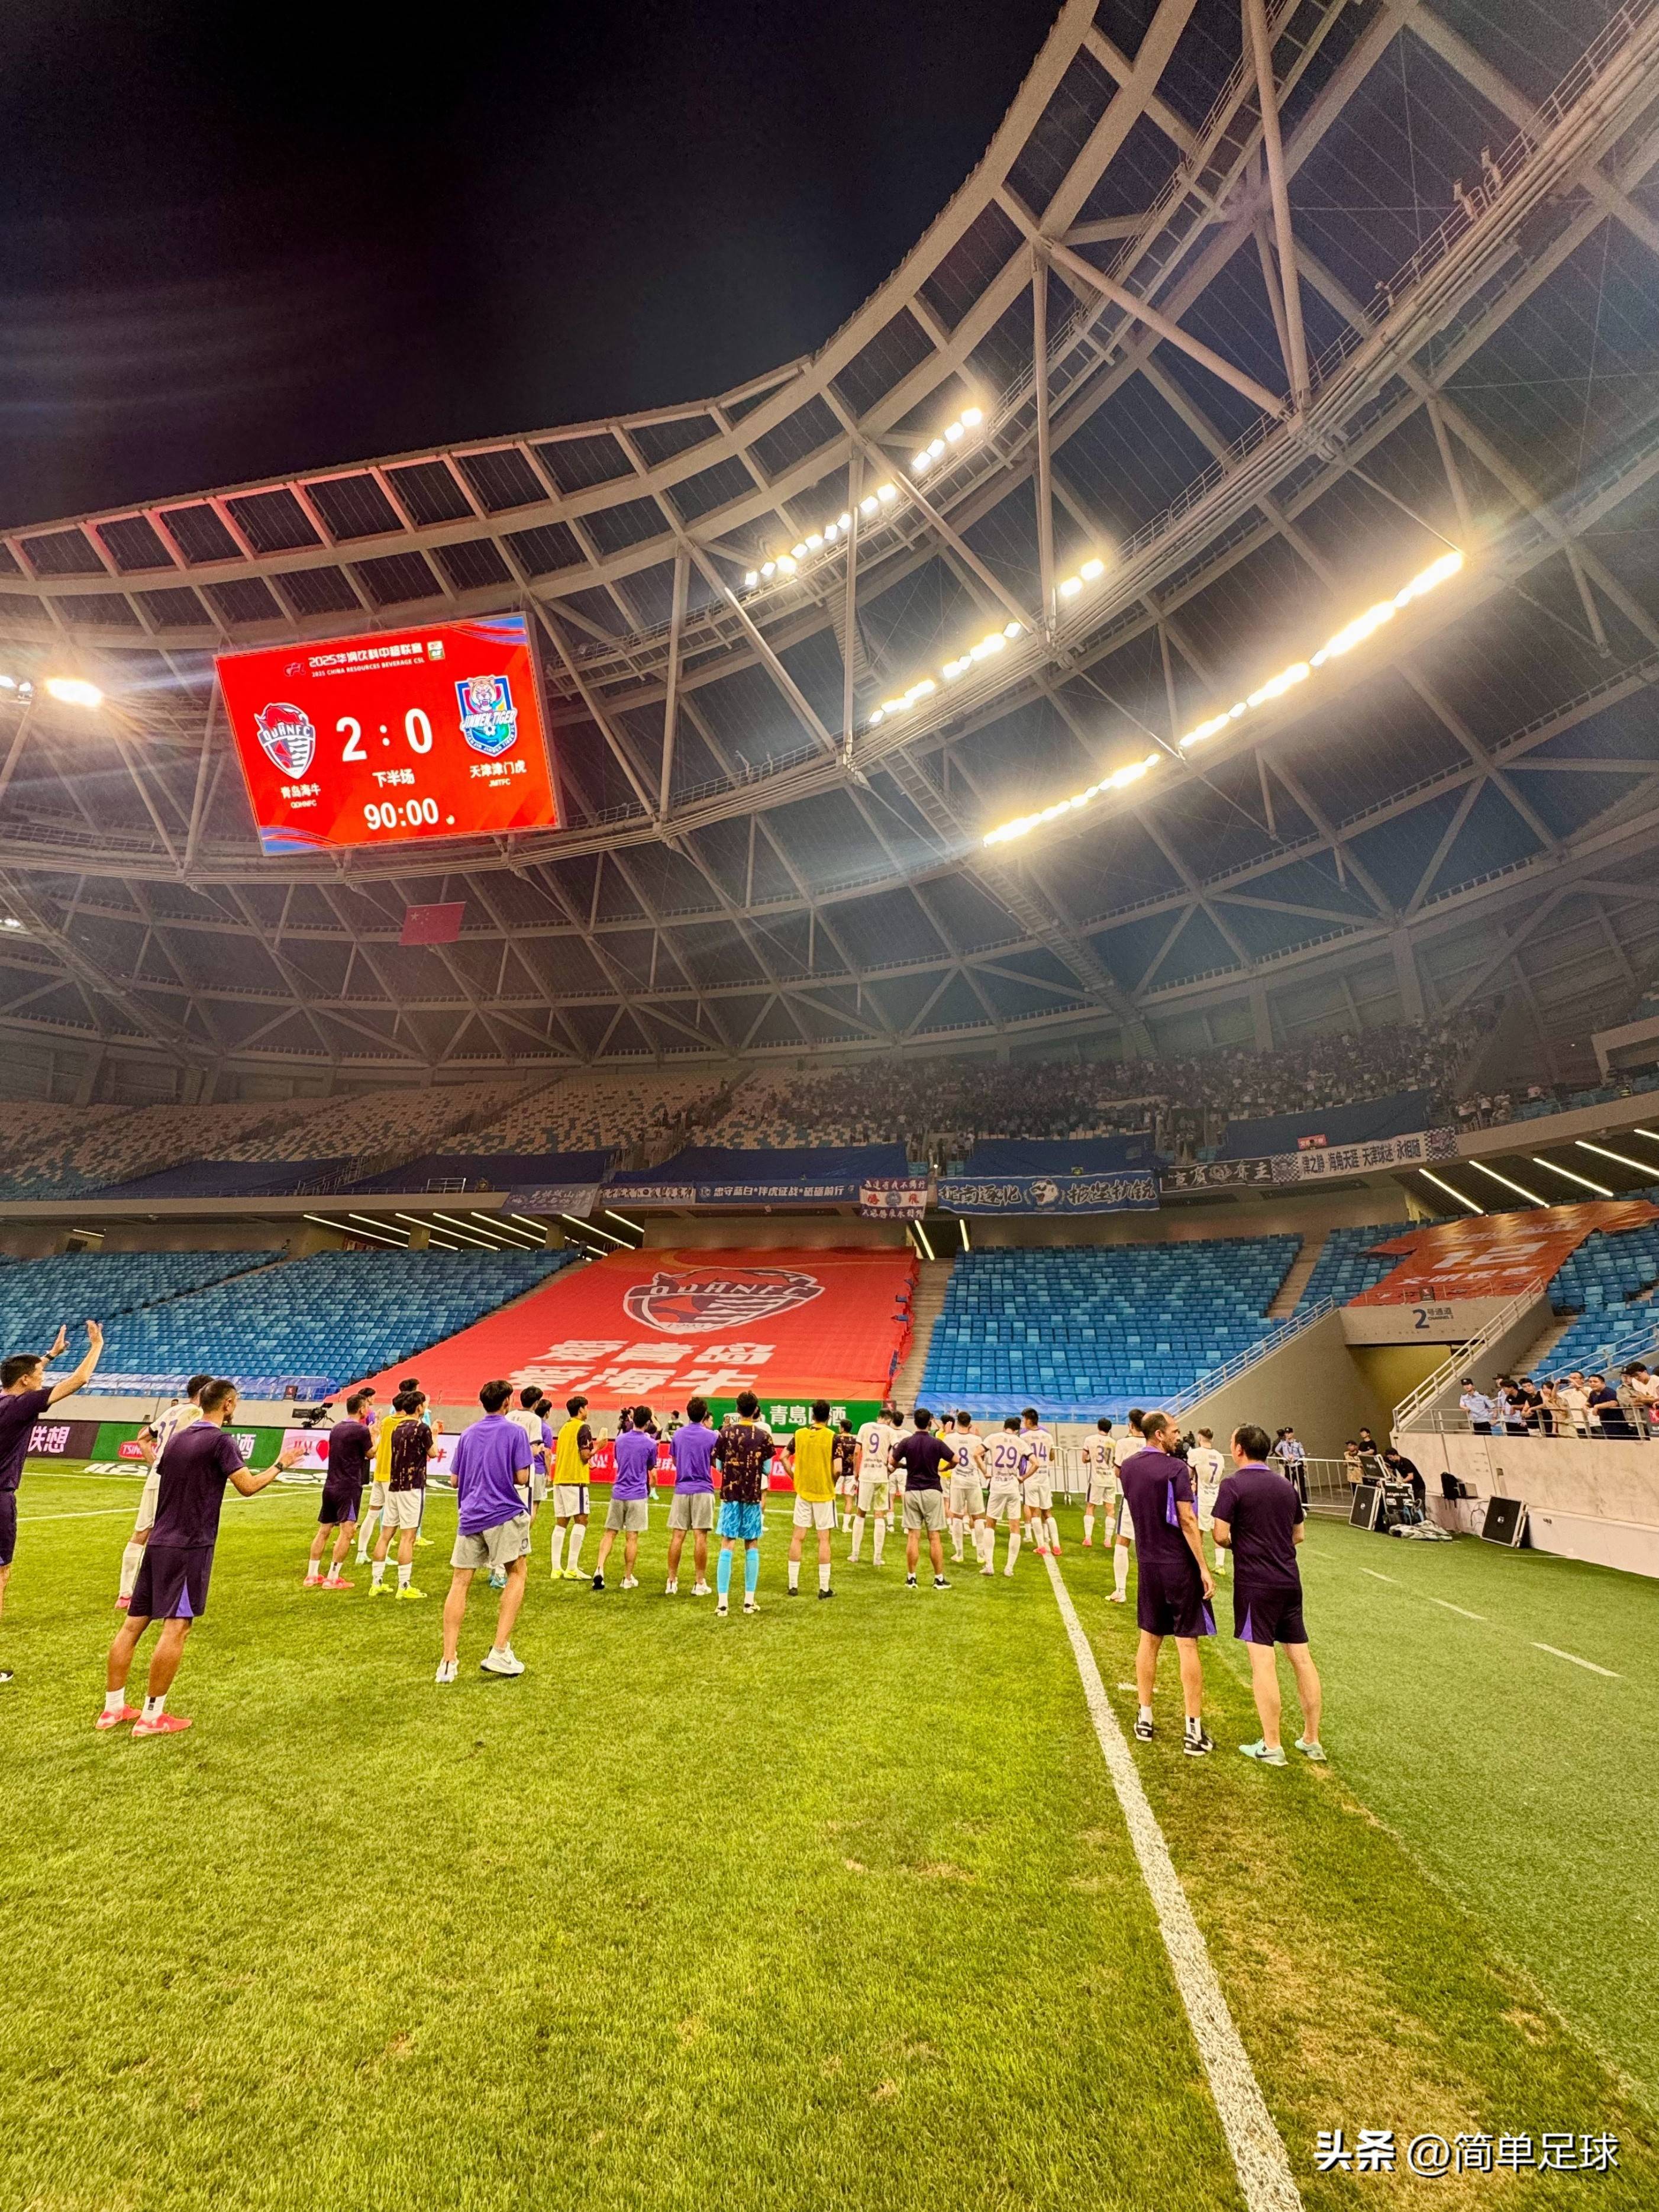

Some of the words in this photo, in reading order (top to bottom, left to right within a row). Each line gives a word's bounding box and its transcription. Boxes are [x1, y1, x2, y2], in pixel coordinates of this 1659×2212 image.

[346, 663, 380, 673] RESOURCES
[381, 660, 412, 669] BEVERAGE
[372, 769, 415, 786] 下半场
[470, 760, 527, 778] 天津津门虎
[280, 783, 321, 799] 青岛海牛
[1412, 1308, 1430, 1329] 2
[529, 1340, 777, 1365] 爱青岛
[506, 1365, 759, 1395] 爱海牛
[869, 1433, 879, 1453] 9
[1031, 1442, 1047, 1462] 14
[958, 1447, 969, 1467] 8
[995, 1444, 1017, 1468] 29
[1209, 1462, 1218, 1483] 7
